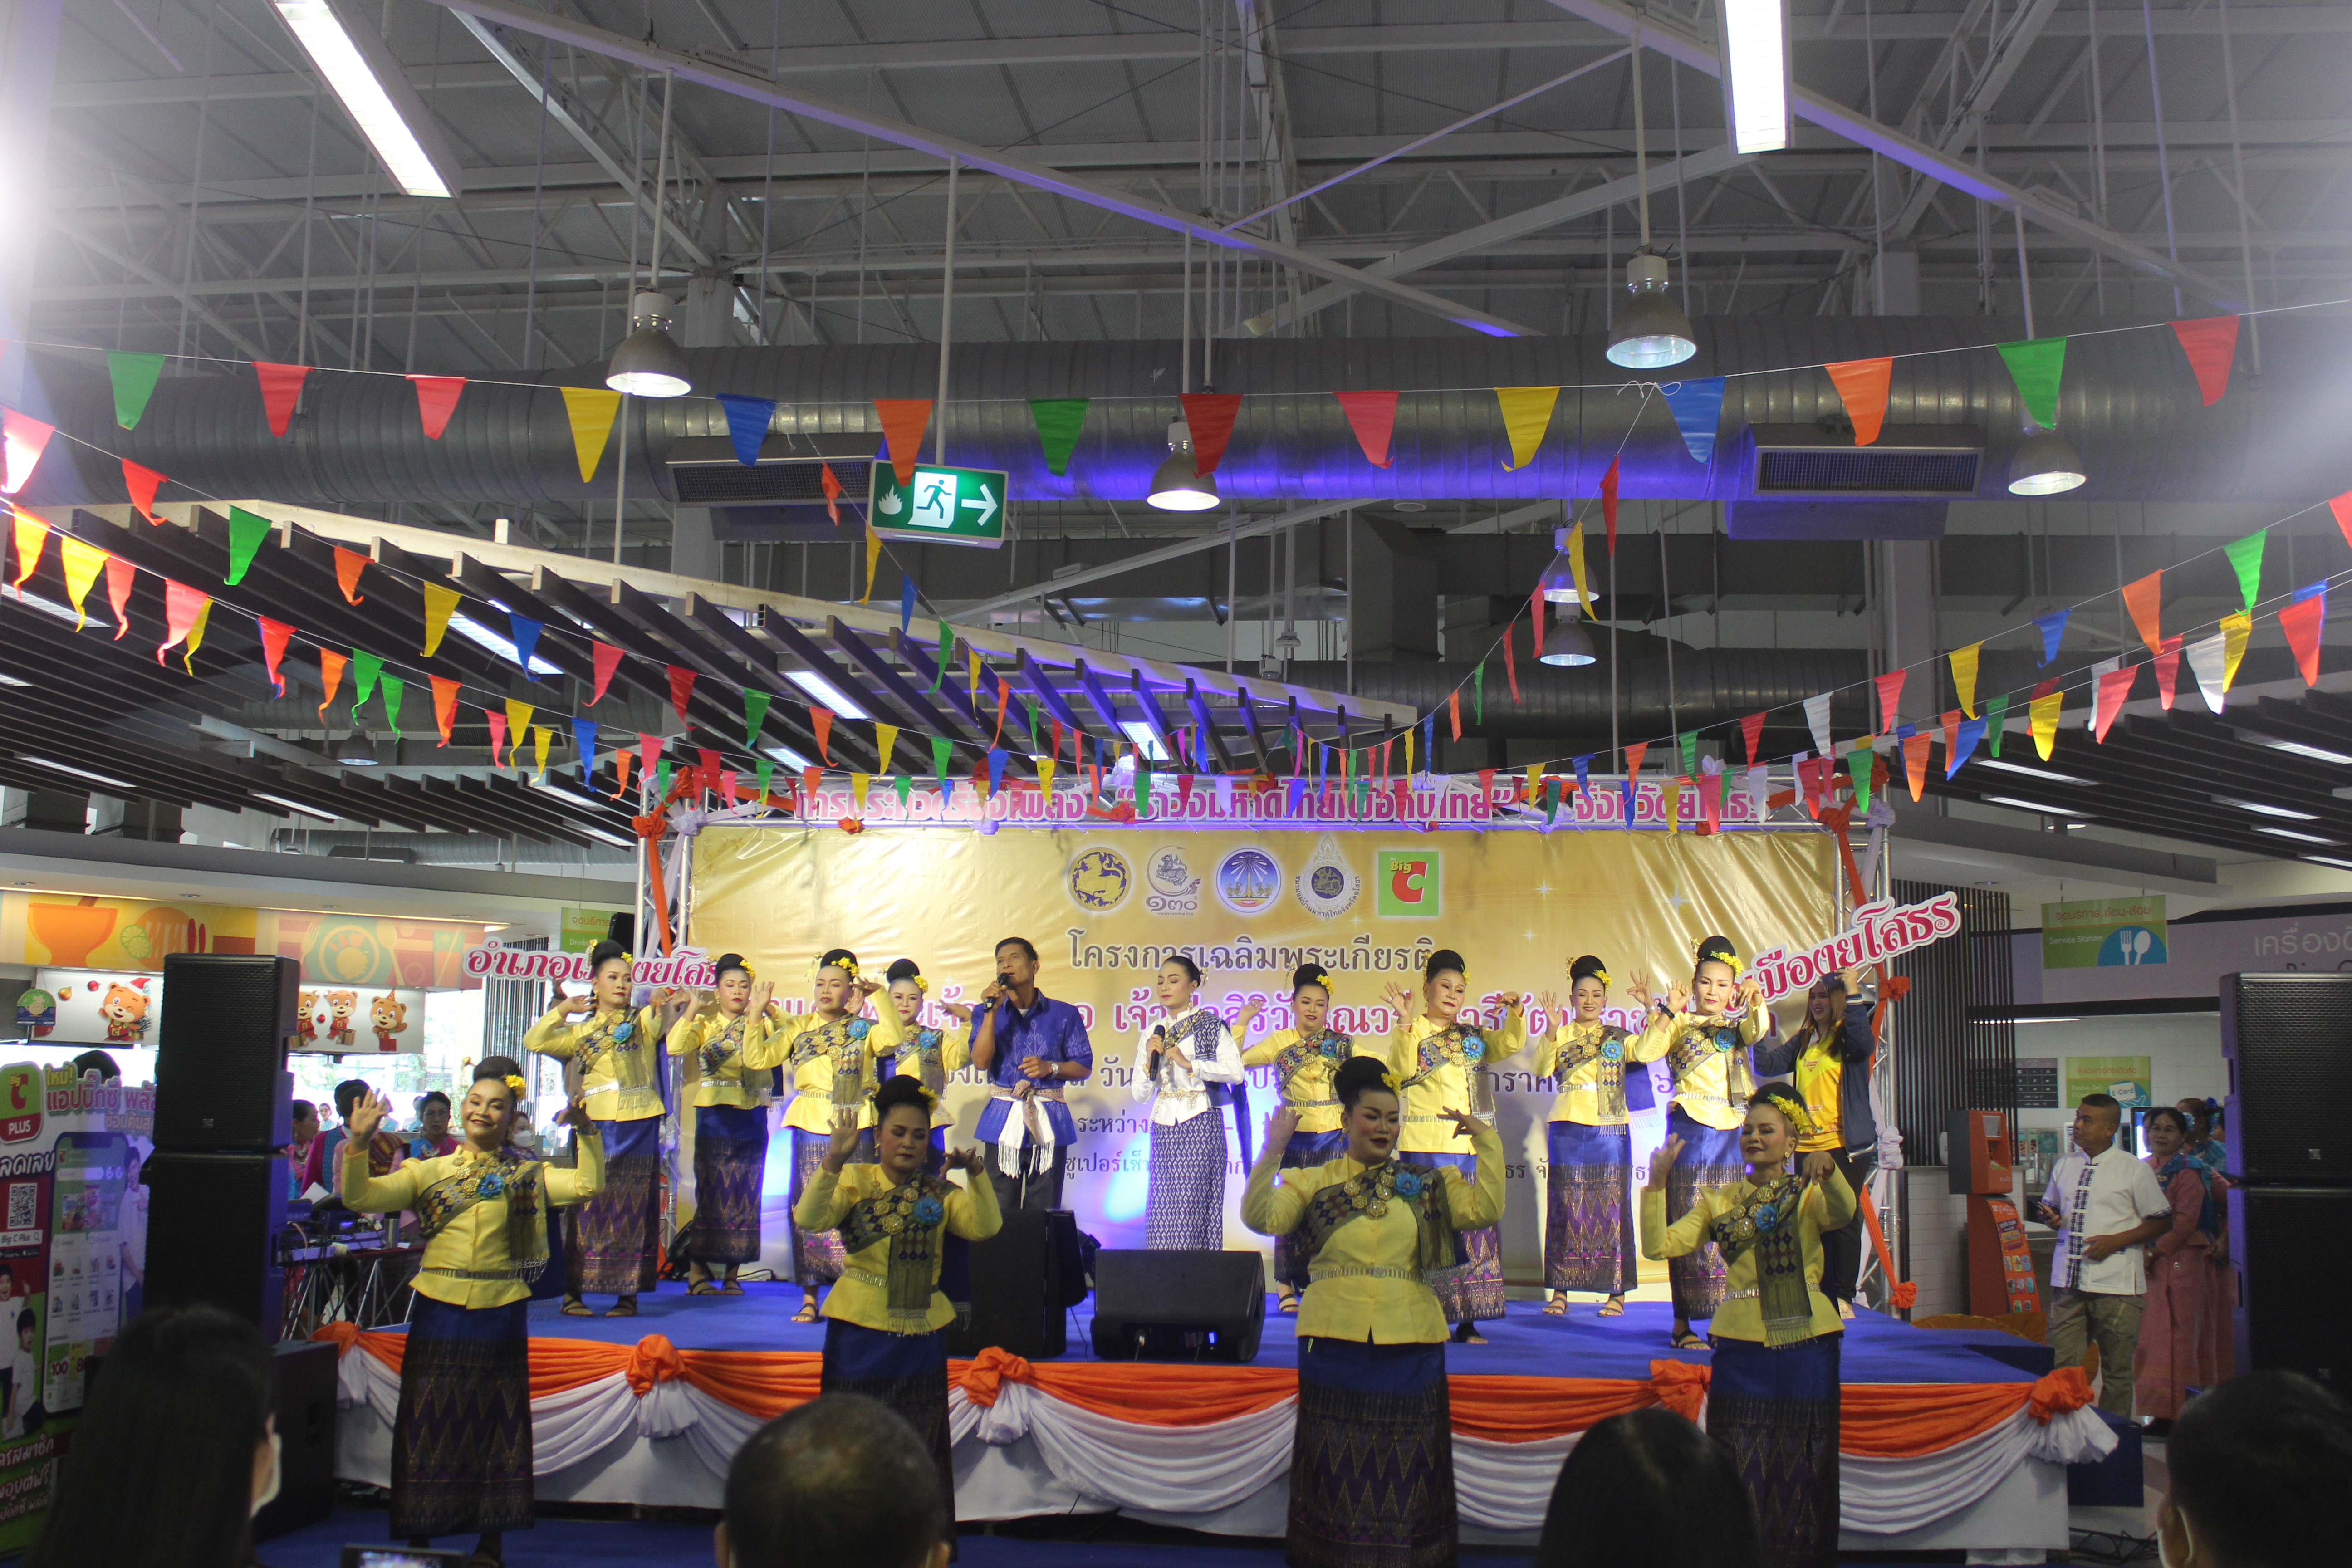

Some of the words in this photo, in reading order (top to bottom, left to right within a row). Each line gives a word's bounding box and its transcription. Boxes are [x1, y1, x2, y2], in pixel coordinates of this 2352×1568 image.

[1391, 861, 1412, 874] Big
[1392, 861, 1428, 904] C
[1146, 896, 1197, 912] ๑๓๐
[2055, 910, 2100, 921] จุดบริการ
[2077, 935, 2103, 943] Station
[46, 1065, 73, 1086] ใหม่!
[47, 1073, 119, 1111] แอปบิ๊กซี
[2112, 1089, 2134, 1097] E-Card
[9, 1120, 31, 1135] PLUS
[52, 1362, 68, 1376] 100
